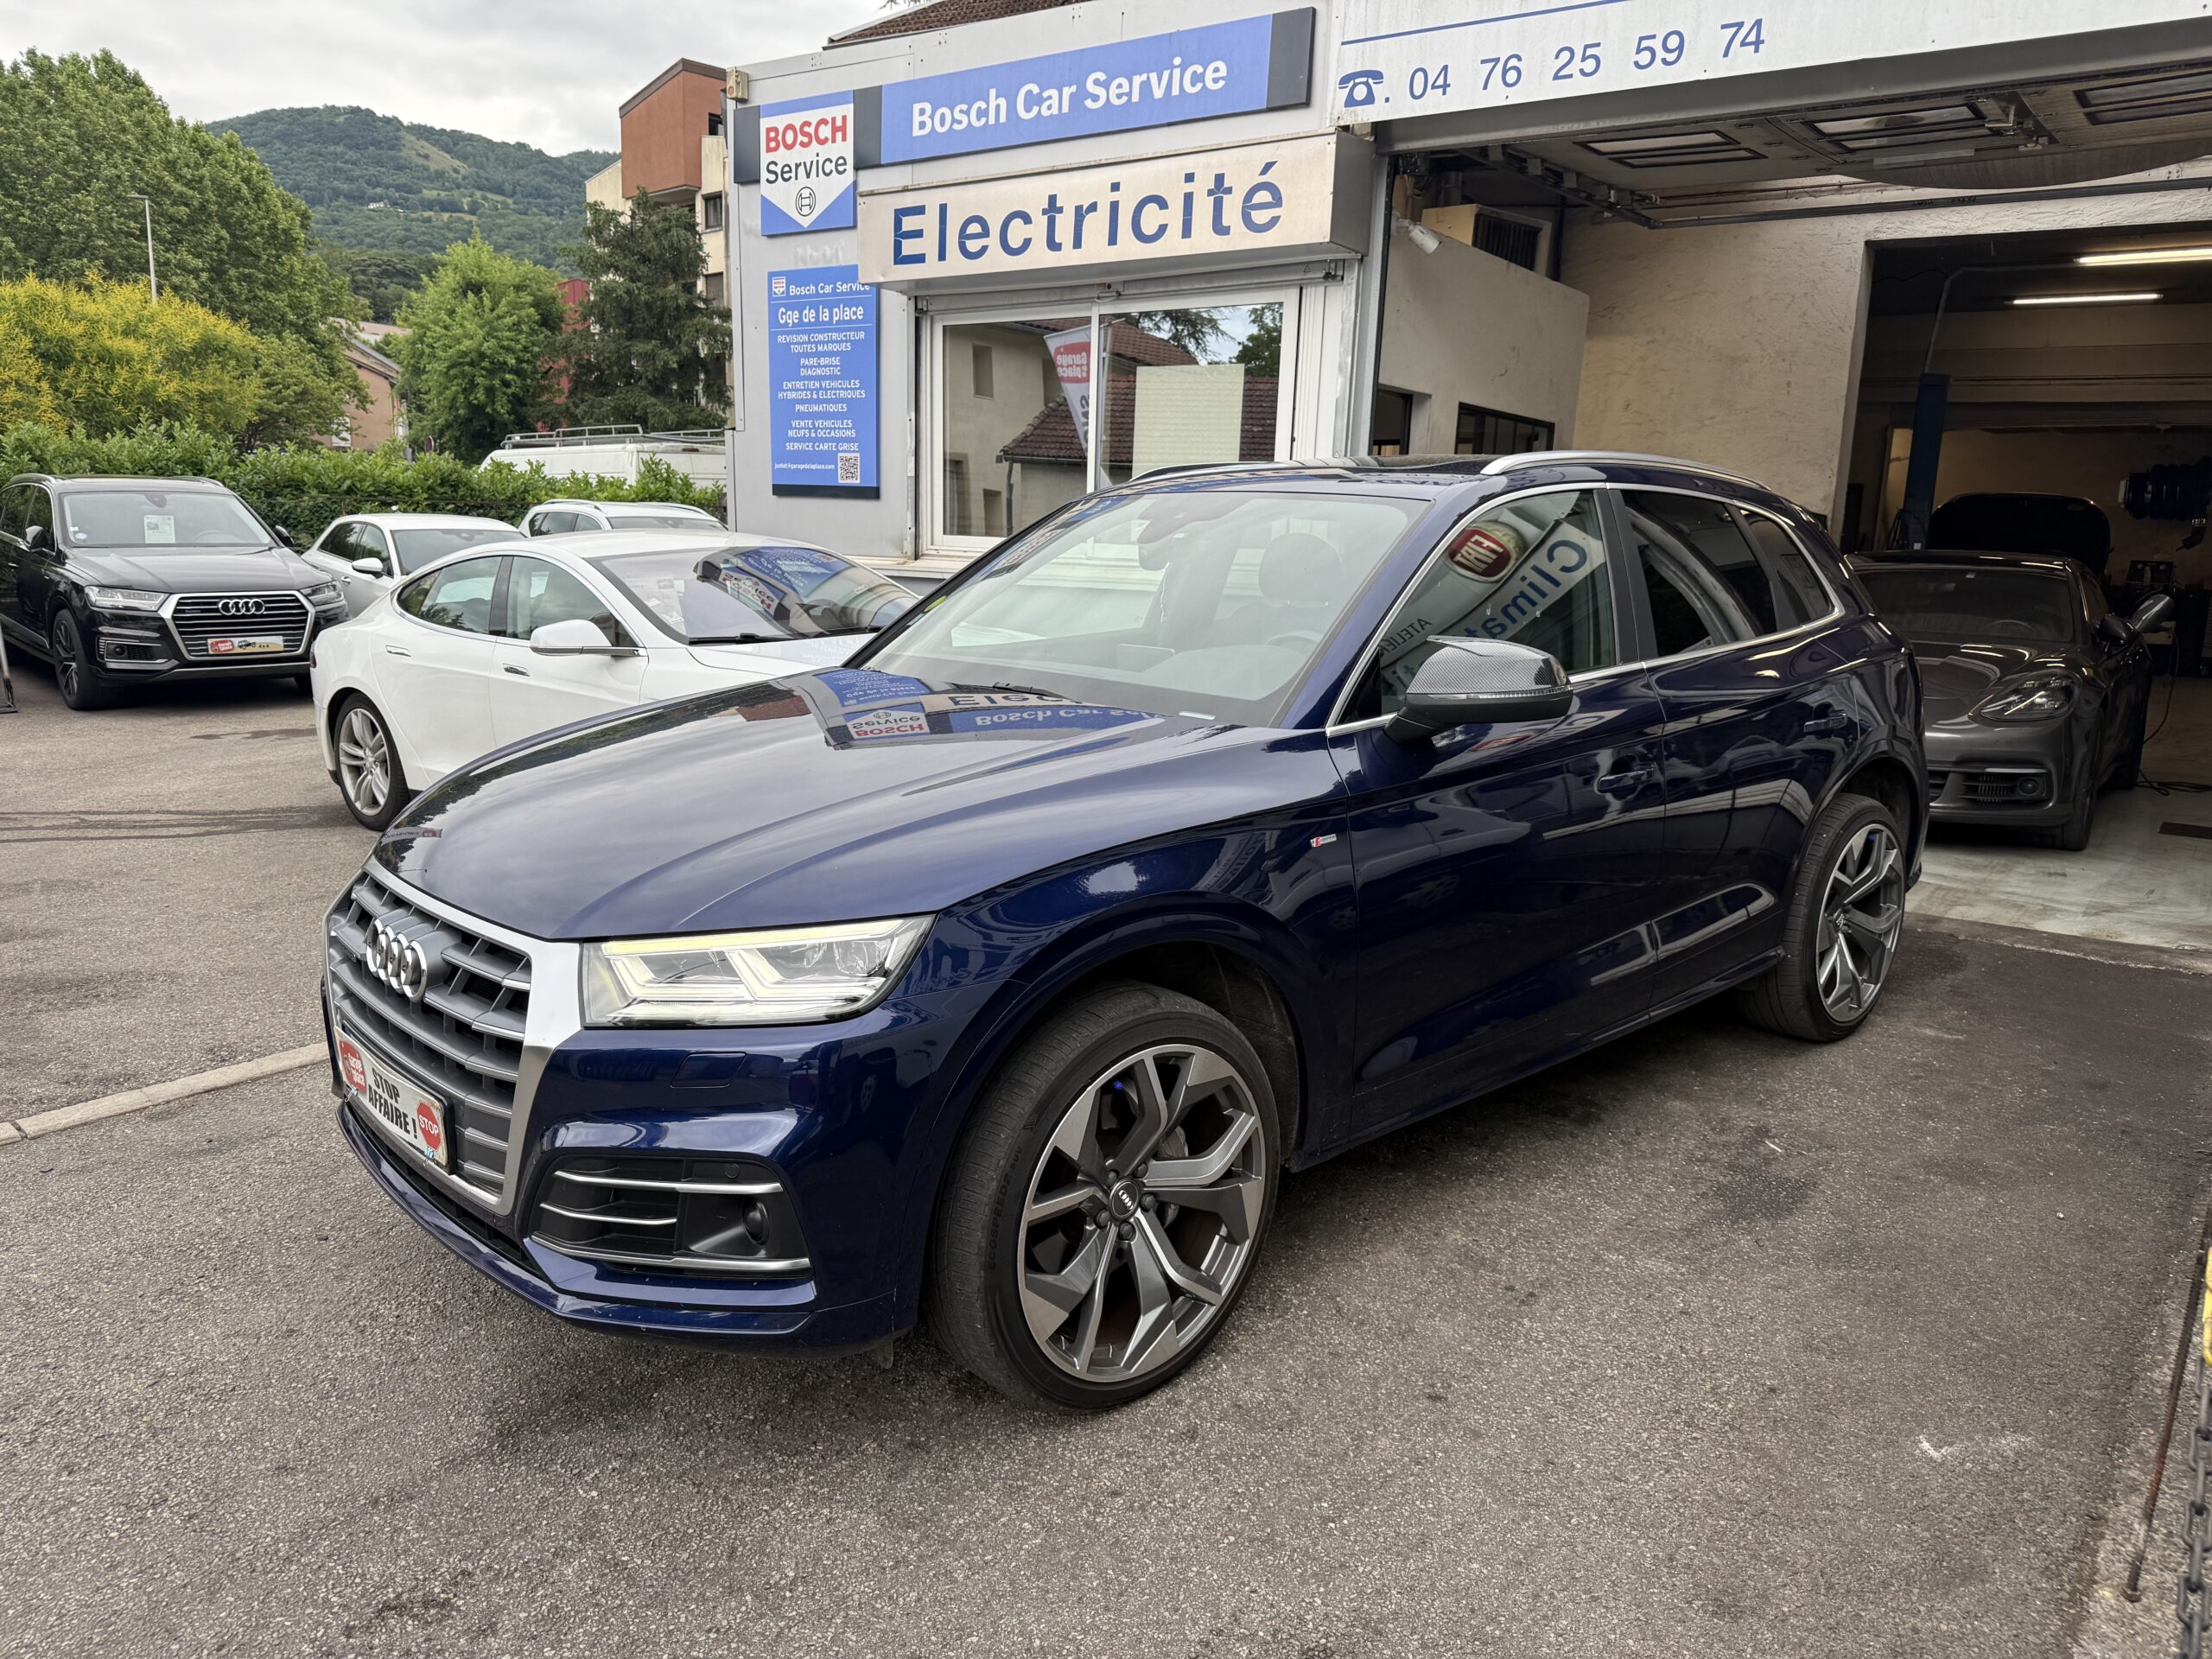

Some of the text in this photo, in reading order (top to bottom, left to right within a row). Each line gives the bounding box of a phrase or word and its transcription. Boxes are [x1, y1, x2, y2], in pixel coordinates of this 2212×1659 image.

[1408, 18, 1765, 99] 04 76 25 59 74
[912, 56, 1227, 137] Bosch Car Service
[765, 114, 848, 153] BOSCH
[766, 154, 848, 184] Service
[893, 161, 1284, 266] Electricité
[790, 285, 816, 296] Bosch
[818, 283, 833, 294] Car
[778, 303, 863, 327] Gge de la place
[778, 331, 865, 343] REVISION CONSTRUCTEUR
[791, 343, 851, 353] TOUTES MARQUES
[800, 357, 841, 365] PARE-BRISE
[800, 367, 841, 376] DIAGNOSTIC
[778, 391, 810, 399] HYBRIDES
[819, 390, 866, 398] ELECTRIQUES
[783, 381, 819, 390] ENTRETIEN
[795, 404, 848, 412] PNEUMATIQUES
[372, 1067, 400, 1104] STOP
[368, 1084, 410, 1135] AFFAIRE
[418, 1116, 439, 1136] STOP
